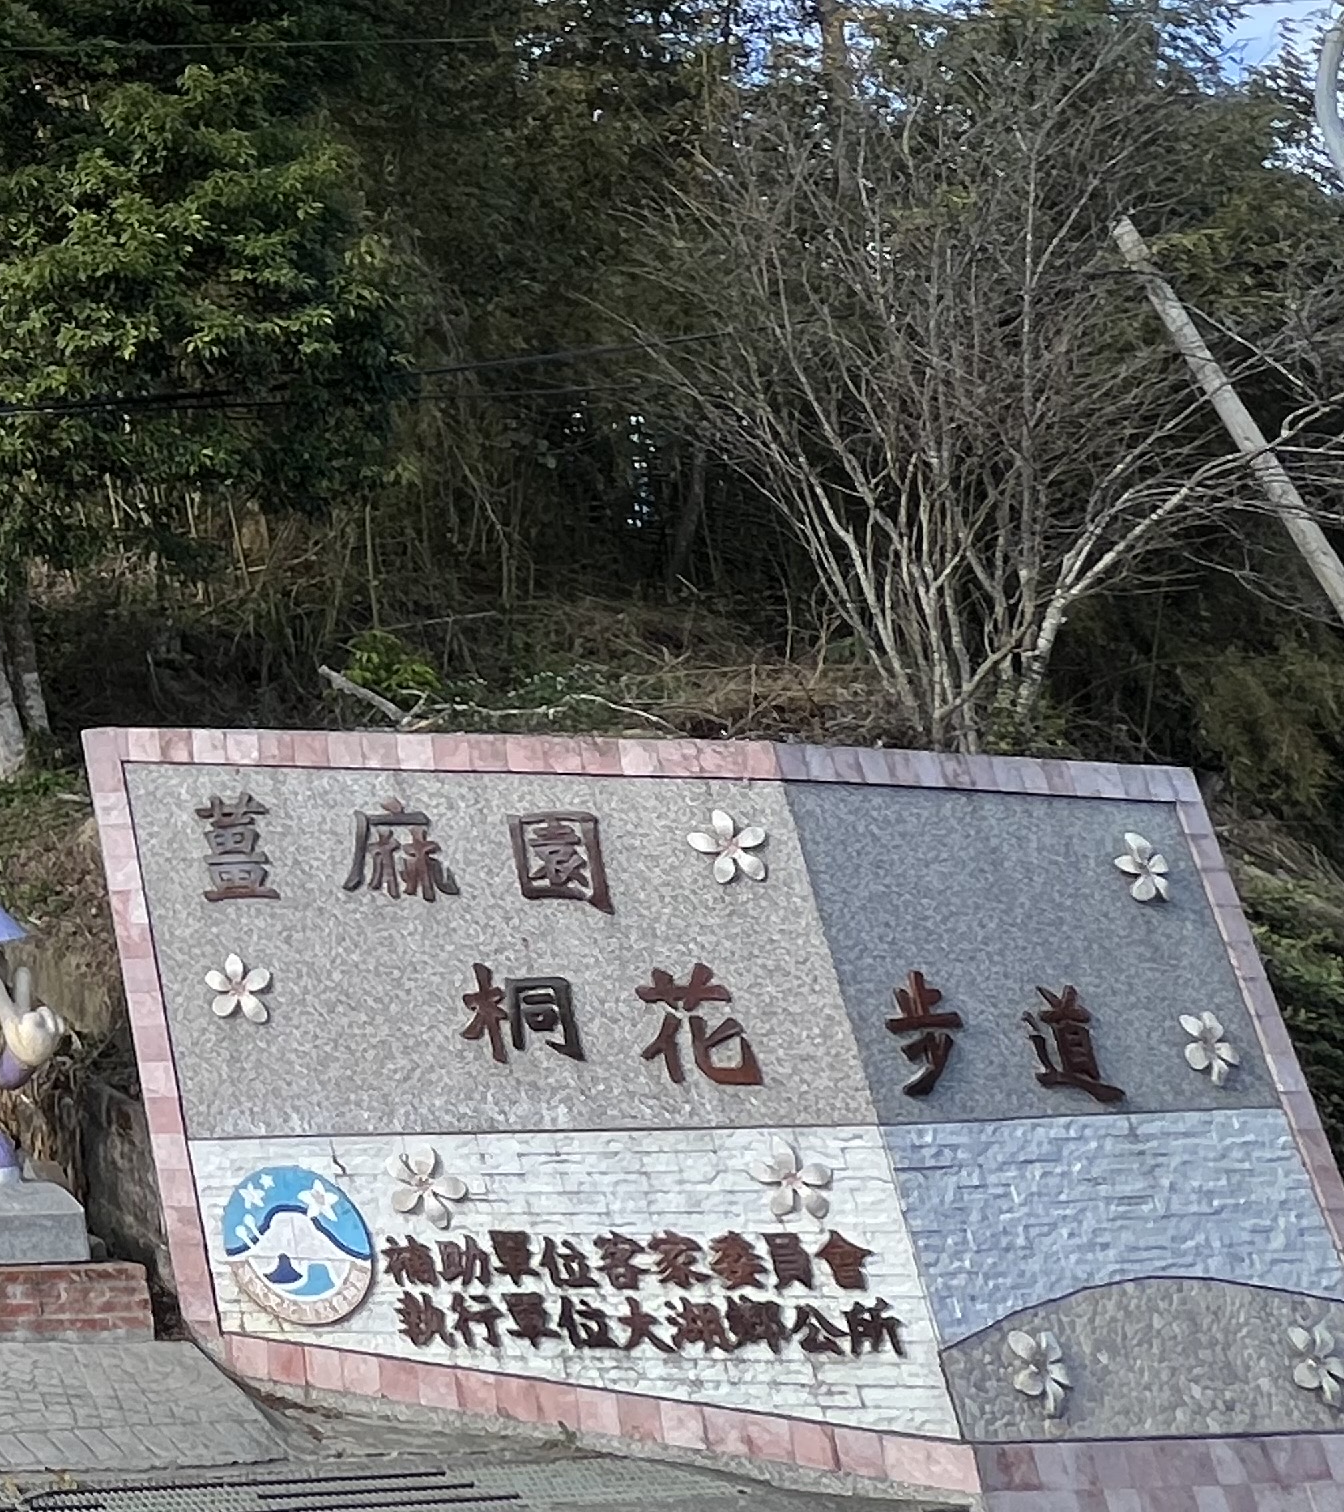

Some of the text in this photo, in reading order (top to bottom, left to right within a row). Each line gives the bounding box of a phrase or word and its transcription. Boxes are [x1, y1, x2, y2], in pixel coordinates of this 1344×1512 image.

[195, 792, 615, 915] 薑麻園
[460, 962, 1126, 1104] 桐花步道
[381, 1230, 874, 1290] 補助單位客家委員會
[398, 1290, 909, 1357] 執行單位大湖鄉公所
